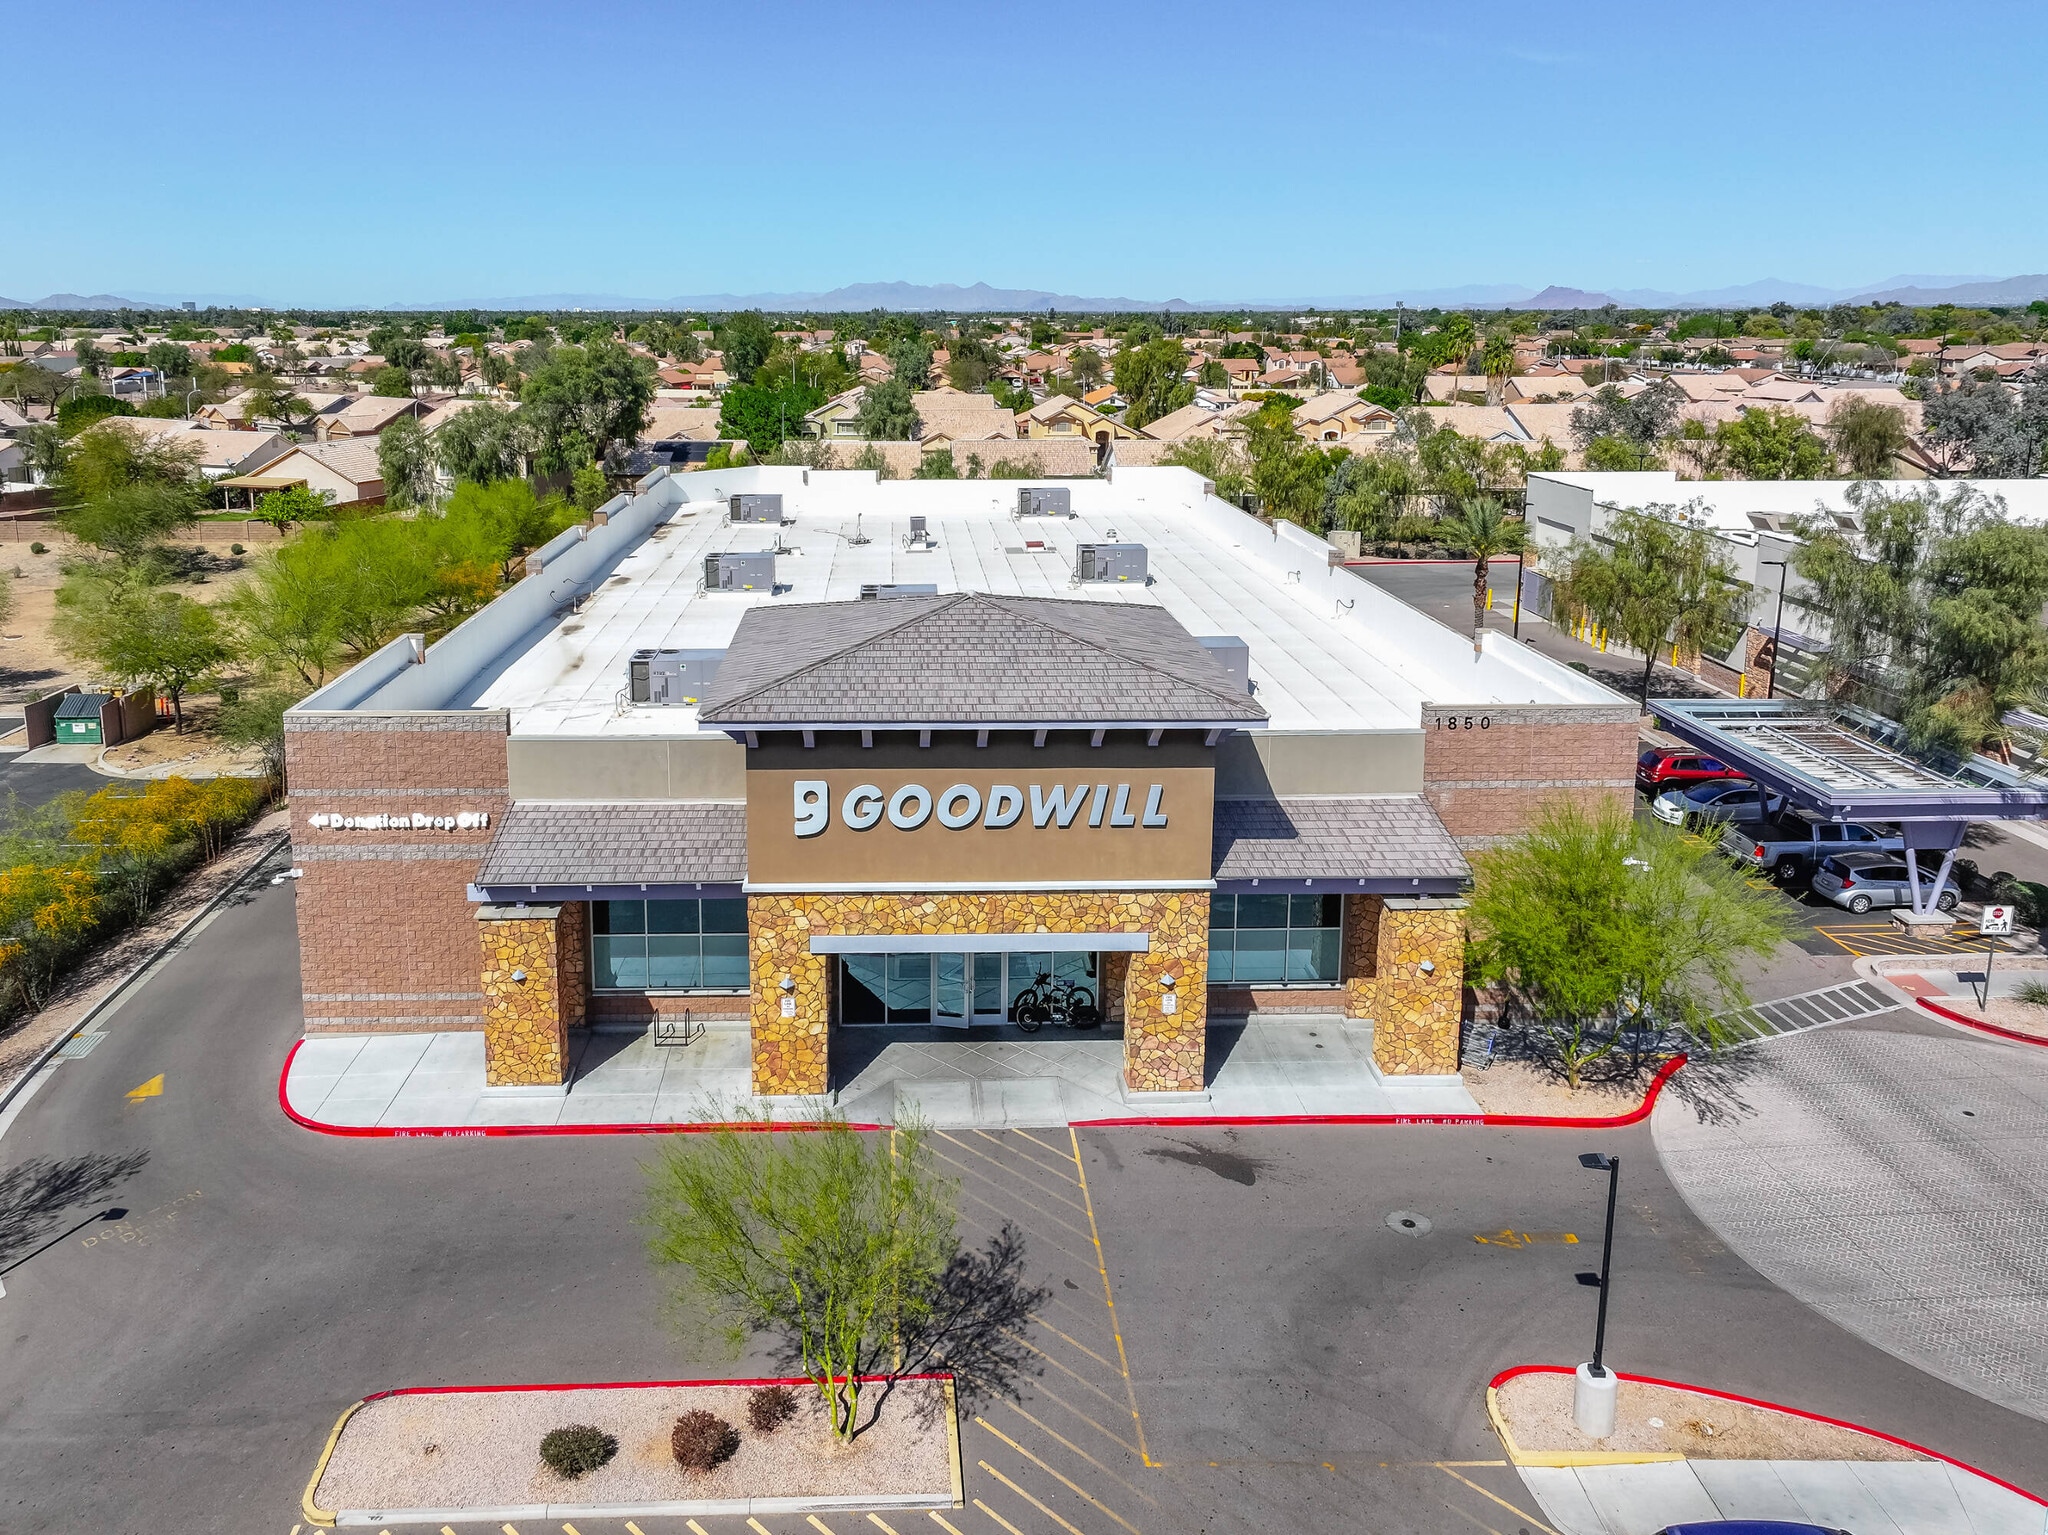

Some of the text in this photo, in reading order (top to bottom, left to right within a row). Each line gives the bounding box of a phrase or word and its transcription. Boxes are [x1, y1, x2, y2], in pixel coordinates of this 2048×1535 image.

[1435, 716, 1490, 730] 1850
[841, 783, 1168, 829] GOODWILL
[330, 812, 490, 831] Donation Drop Off
[1455, 1118, 1484, 1126] PARKING
[455, 1129, 487, 1137] PARKING
